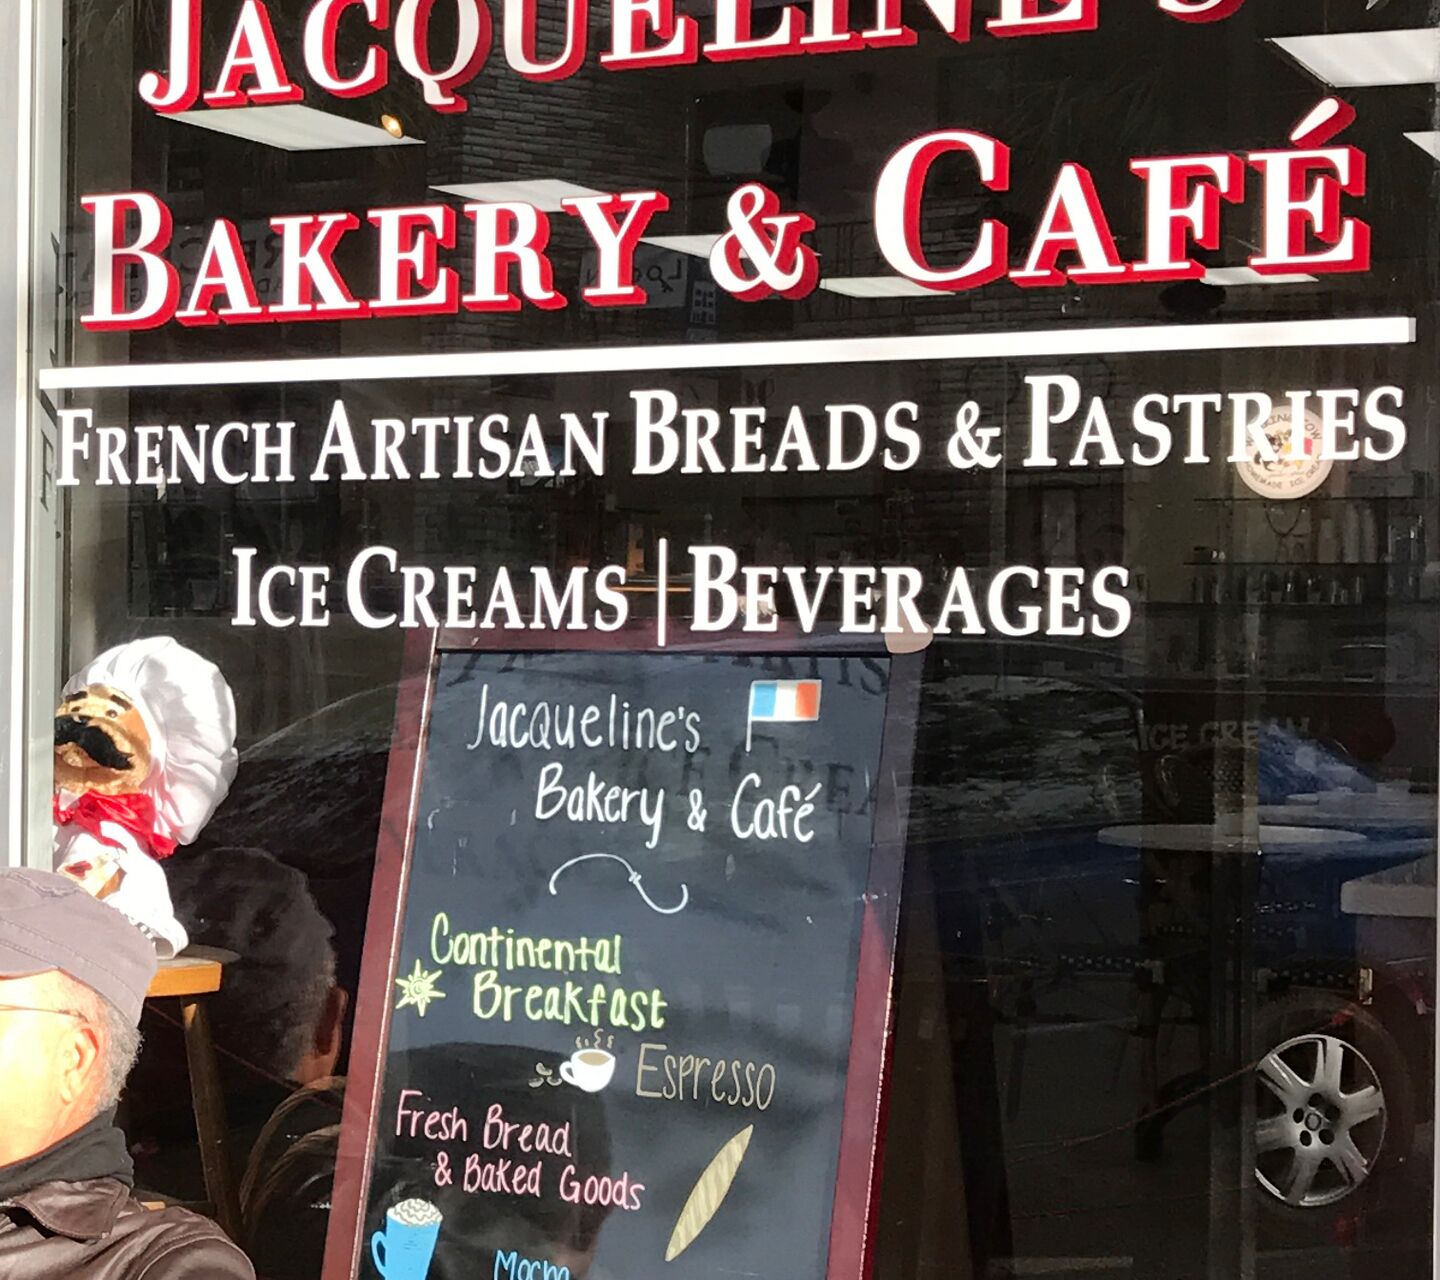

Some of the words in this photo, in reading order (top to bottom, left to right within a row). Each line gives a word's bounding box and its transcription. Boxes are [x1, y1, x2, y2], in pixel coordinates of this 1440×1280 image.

[80, 190, 668, 332] BAKERY
[709, 182, 819, 302] &
[873, 97, 1371, 292] CAFÉ
[57, 407, 295, 486] FRENCH
[310, 399, 609, 482] ARTISAN
[631, 388, 921, 476] BREADS
[948, 400, 1002, 471] &
[1023, 373, 1407, 469] PASTRIES
[231, 546, 331, 628] ICE
[346, 545, 629, 632] CREAMS
[688, 544, 1131, 639] BEVERAGES
[467, 683, 701, 753] Jacqueline's
[534, 761, 665, 849] Bakery
[687, 788, 708, 832] &
[730, 772, 822, 842] Café
[431, 912, 622, 974] Continental
[473, 970, 668, 1032] Breakfast
[635, 1043, 776, 1111] Espresso
[395, 1089, 468, 1142] Fresh
[483, 1103, 572, 1158] Bread
[434, 1151, 453, 1187] &
[463, 1152, 542, 1198] Baked
[560, 1164, 645, 1211] Goods
